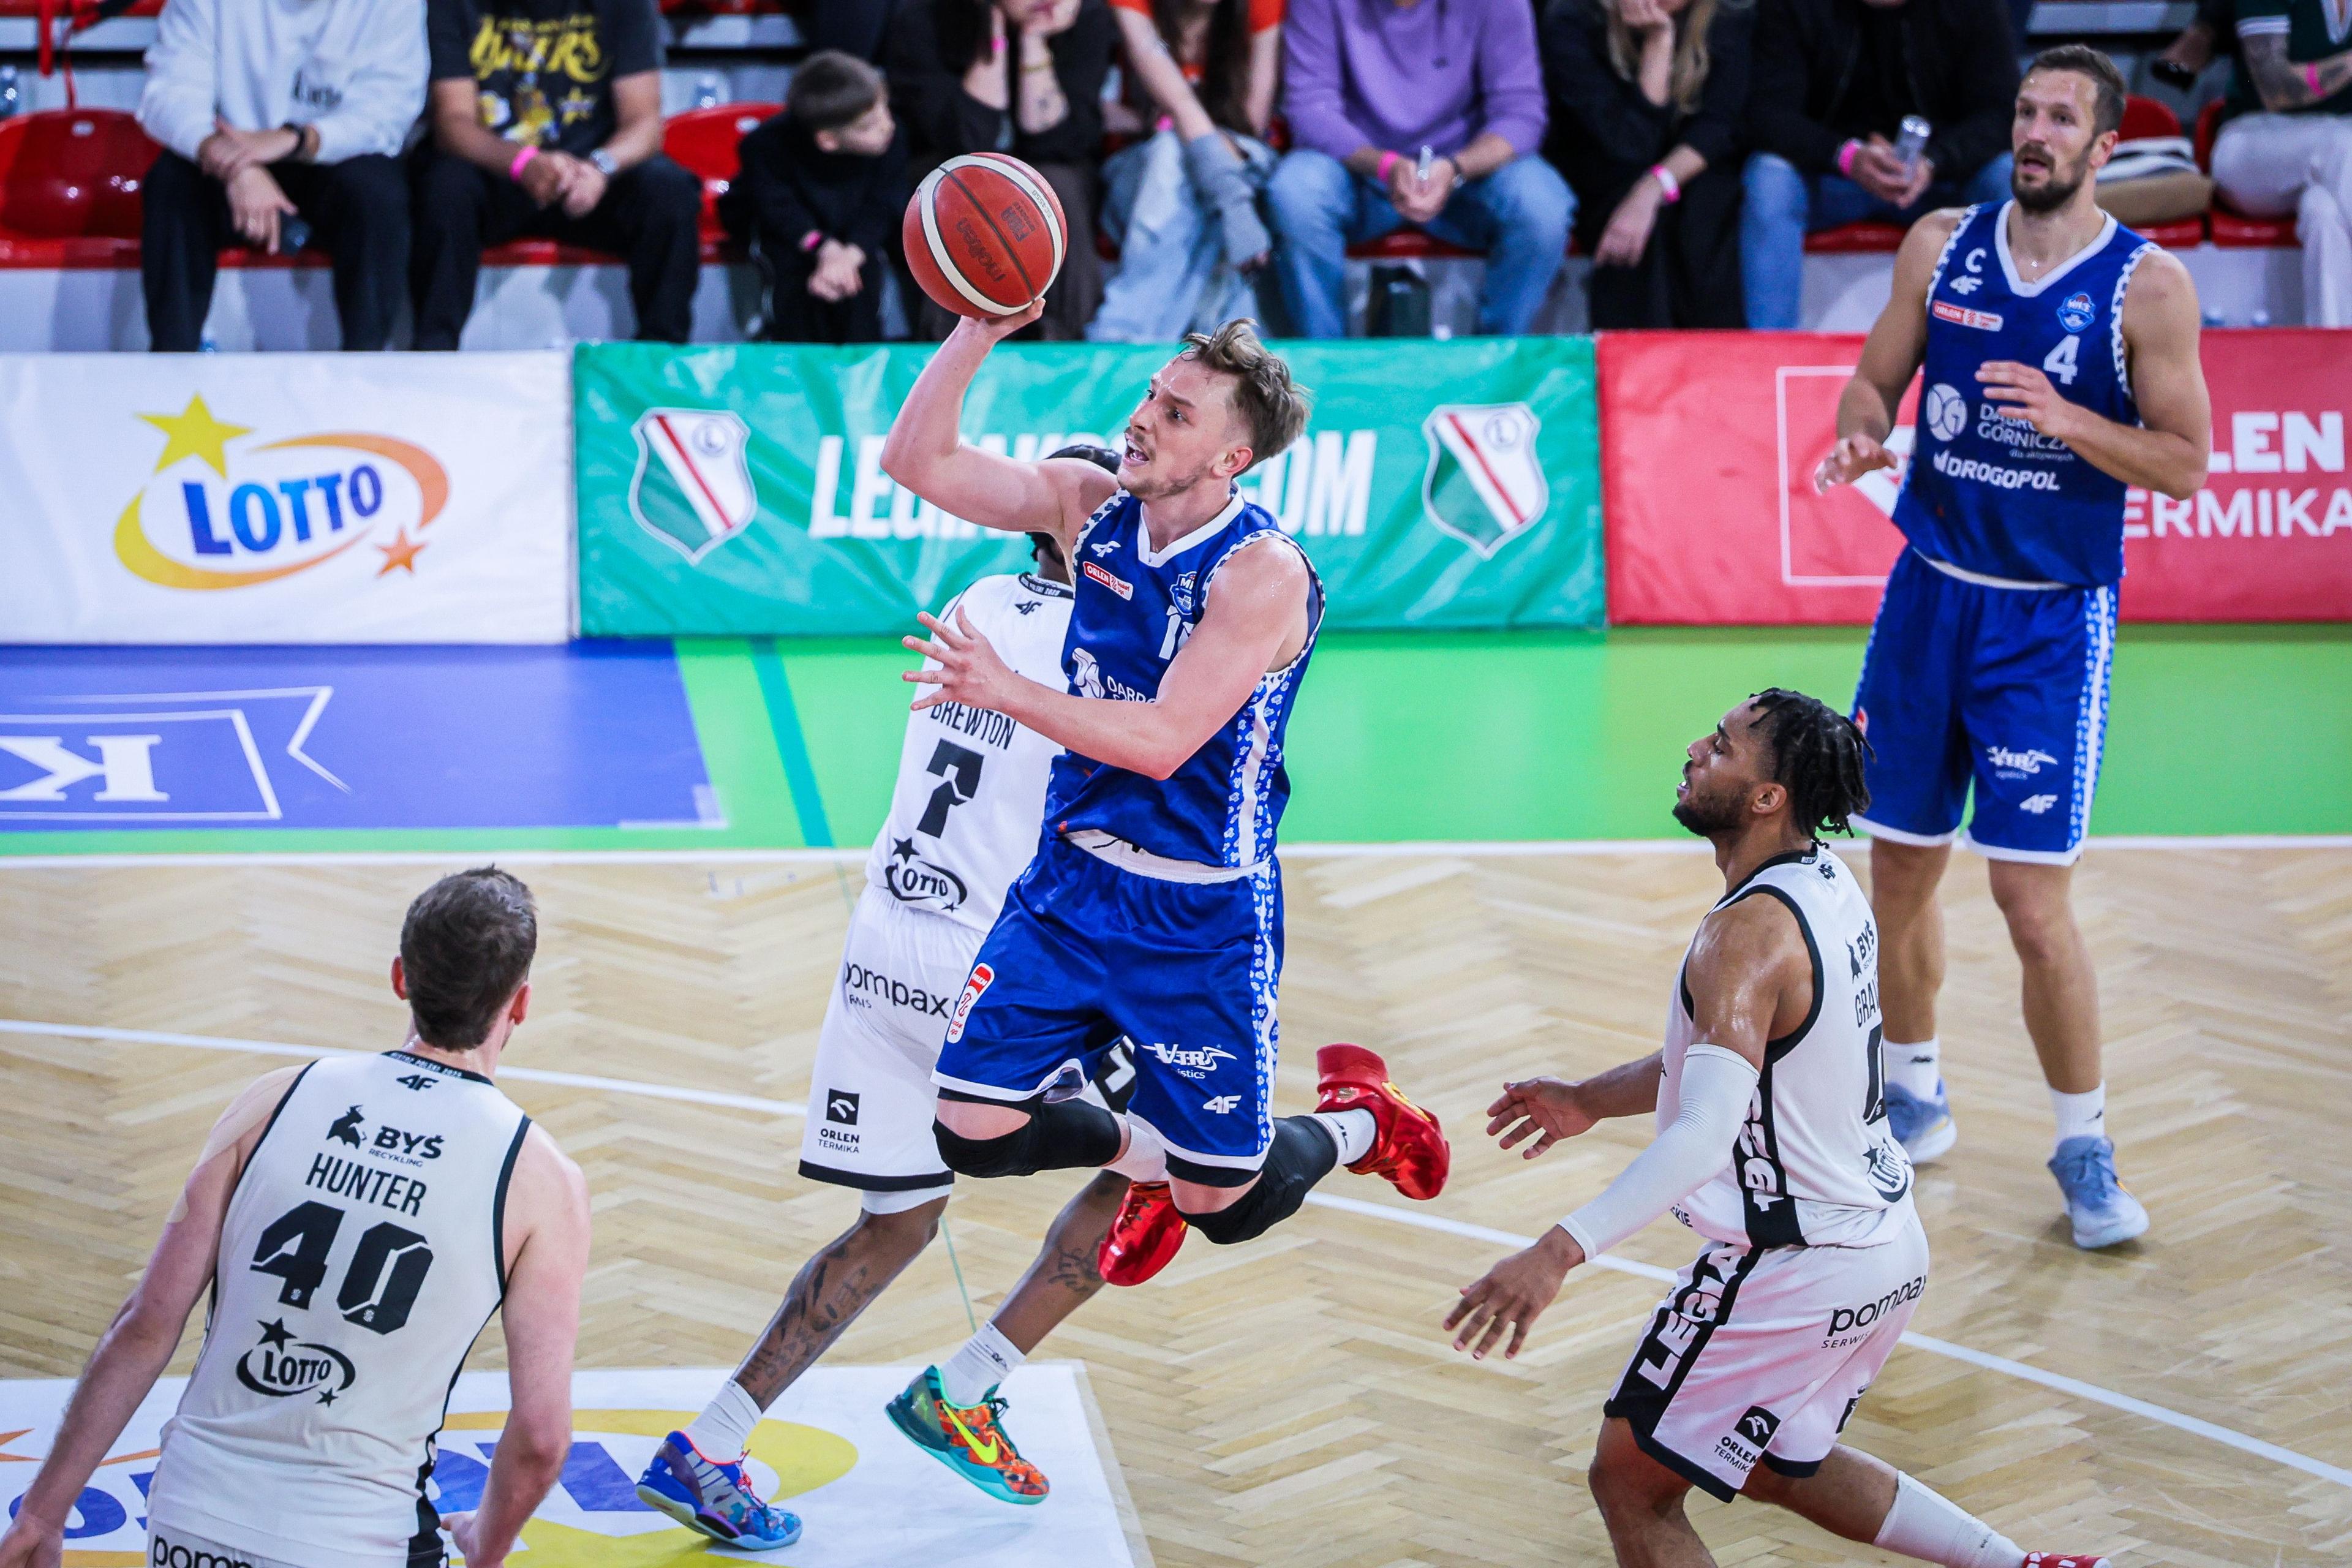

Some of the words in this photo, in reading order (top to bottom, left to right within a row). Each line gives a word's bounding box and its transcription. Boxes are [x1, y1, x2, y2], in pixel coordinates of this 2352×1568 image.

[956, 217, 1006, 282] molten
[1965, 247, 1987, 273] C
[2043, 334, 2081, 385] 4
[1947, 457, 2060, 491] DROGOPOL
[183, 464, 382, 556] LOTTO
[2124, 488, 2352, 538] ERMIKA
[930, 700, 1017, 750] BREWTON
[916, 737, 985, 839] 7
[902, 867, 949, 897] OTTO
[1202, 1095, 1242, 1114] 4F
[818, 1138, 860, 1153] TERMIKA
[820, 1128, 860, 1144] ORLEN
[368, 1147, 424, 1167] RECYKLING
[305, 1152, 428, 1218] HUNTER
[249, 1200, 434, 1336] 40
[263, 1349, 331, 1387] LOTTO
[1714, 1444, 1751, 1473] TERMIK
[1721, 1436, 1757, 1464] ORLEN
